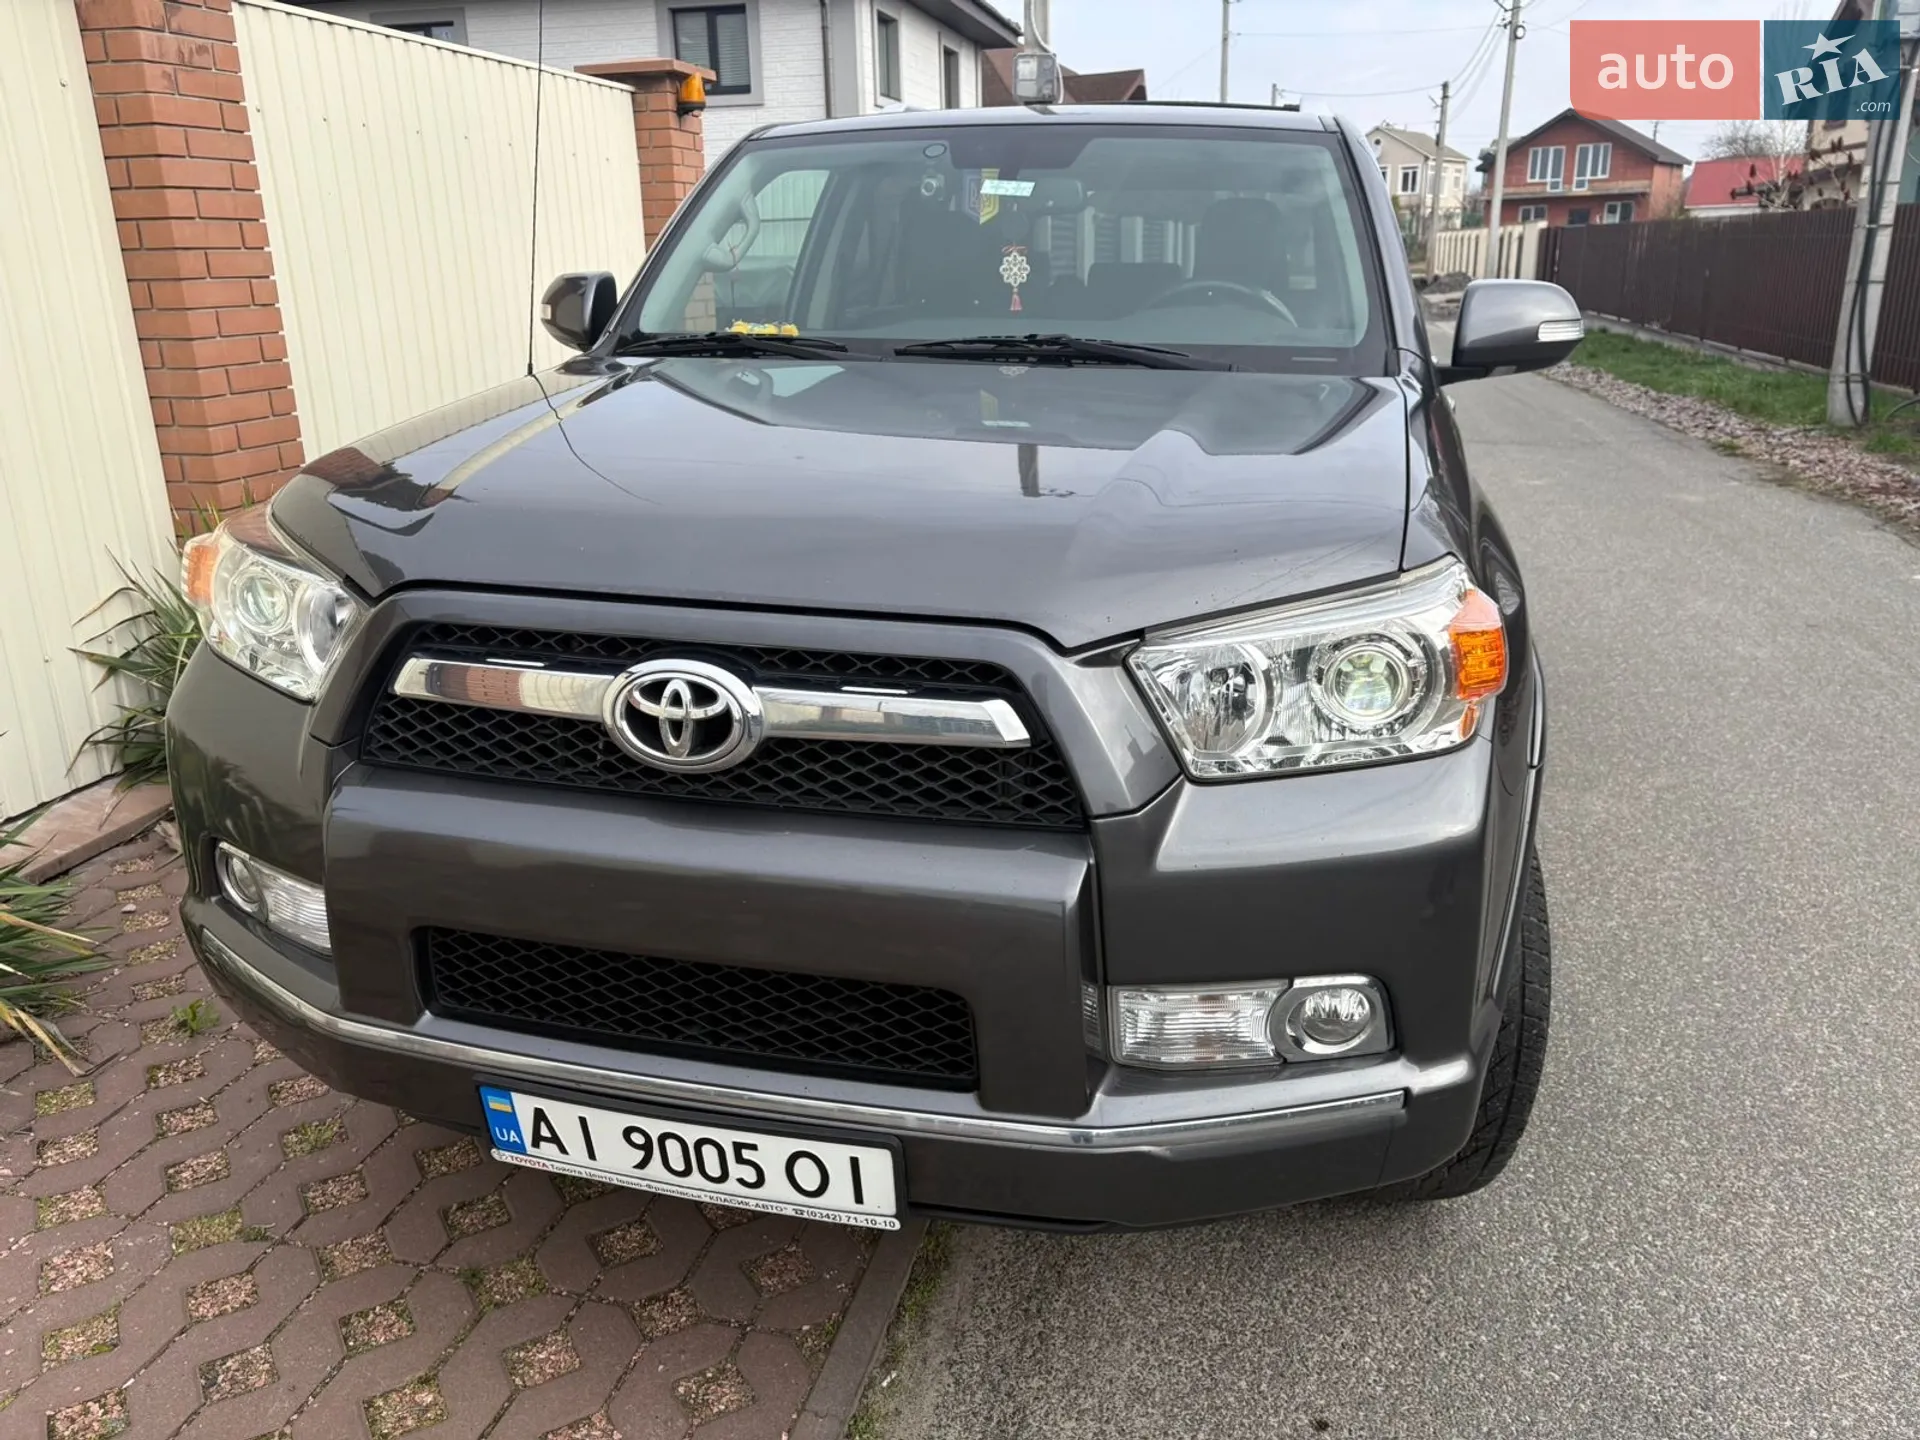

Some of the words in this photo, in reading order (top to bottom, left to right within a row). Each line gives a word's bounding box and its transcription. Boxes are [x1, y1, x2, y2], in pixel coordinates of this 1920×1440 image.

[495, 1127, 521, 1144] UA
[509, 1155, 550, 1170] TOYOTA
[531, 1107, 597, 1161] AI
[622, 1125, 765, 1190] 9005
[785, 1150, 864, 1204] OI
[845, 1214, 896, 1229] 71-10-10
